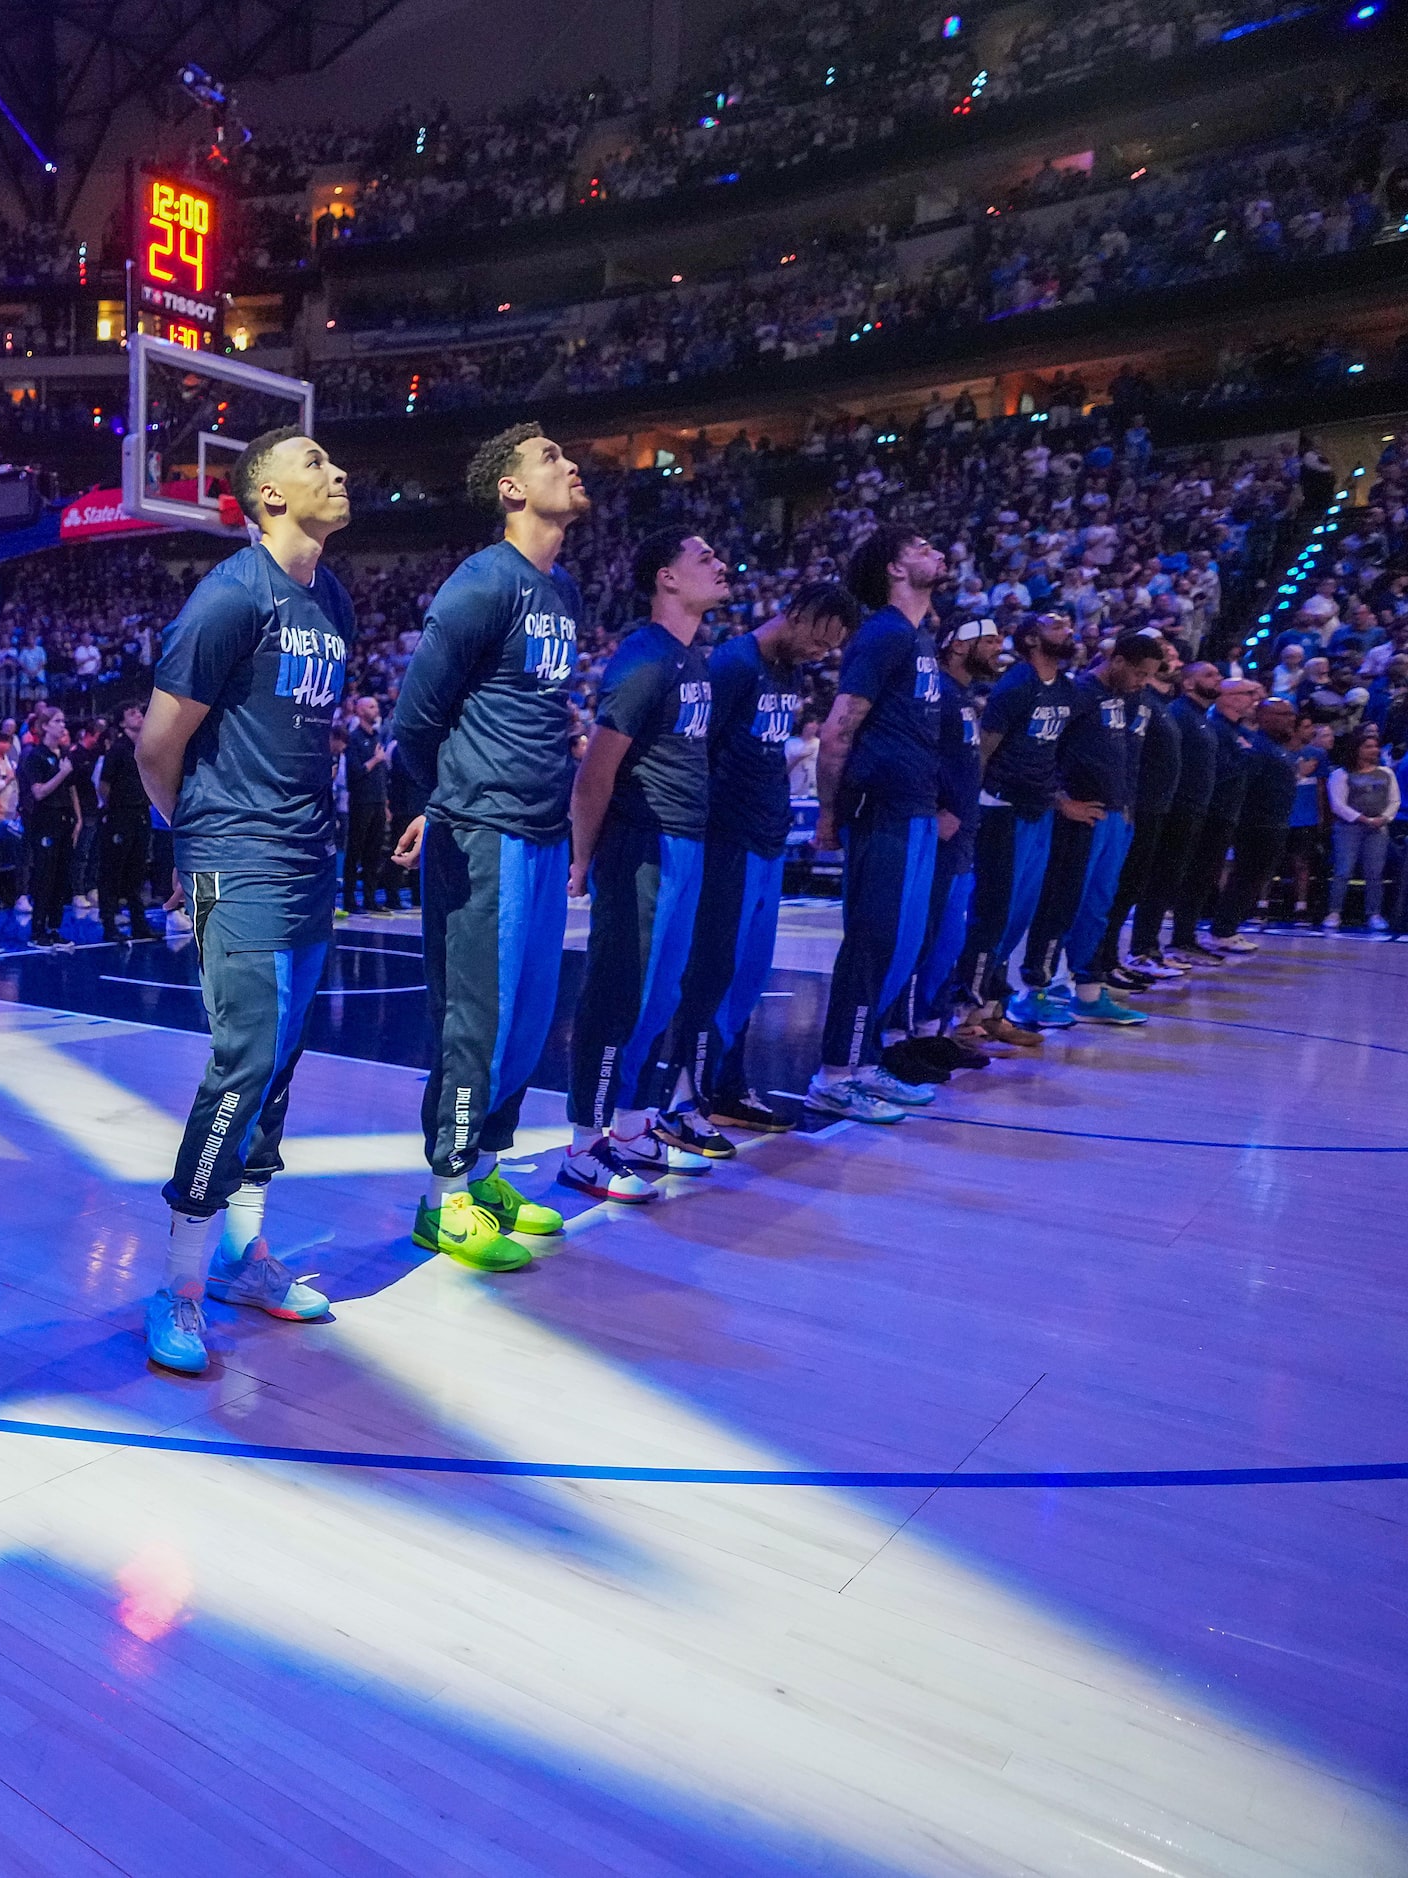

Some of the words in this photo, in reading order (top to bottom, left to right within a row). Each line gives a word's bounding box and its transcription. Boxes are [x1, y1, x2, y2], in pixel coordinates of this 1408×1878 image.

[152, 182, 209, 235] 12:00
[149, 216, 203, 292] 24
[163, 290, 216, 322] TISSOT
[82, 504, 115, 525] State
[280, 625, 313, 657] ONE
[523, 611, 551, 640] ONE
[535, 637, 572, 681] ALL
[293, 655, 335, 708] ALL
[760, 711, 791, 743] ALL
[211, 1091, 241, 1137] DALLAS
[455, 1086, 472, 1126] DALLAS
[189, 1133, 224, 1201] MAVERICKS
